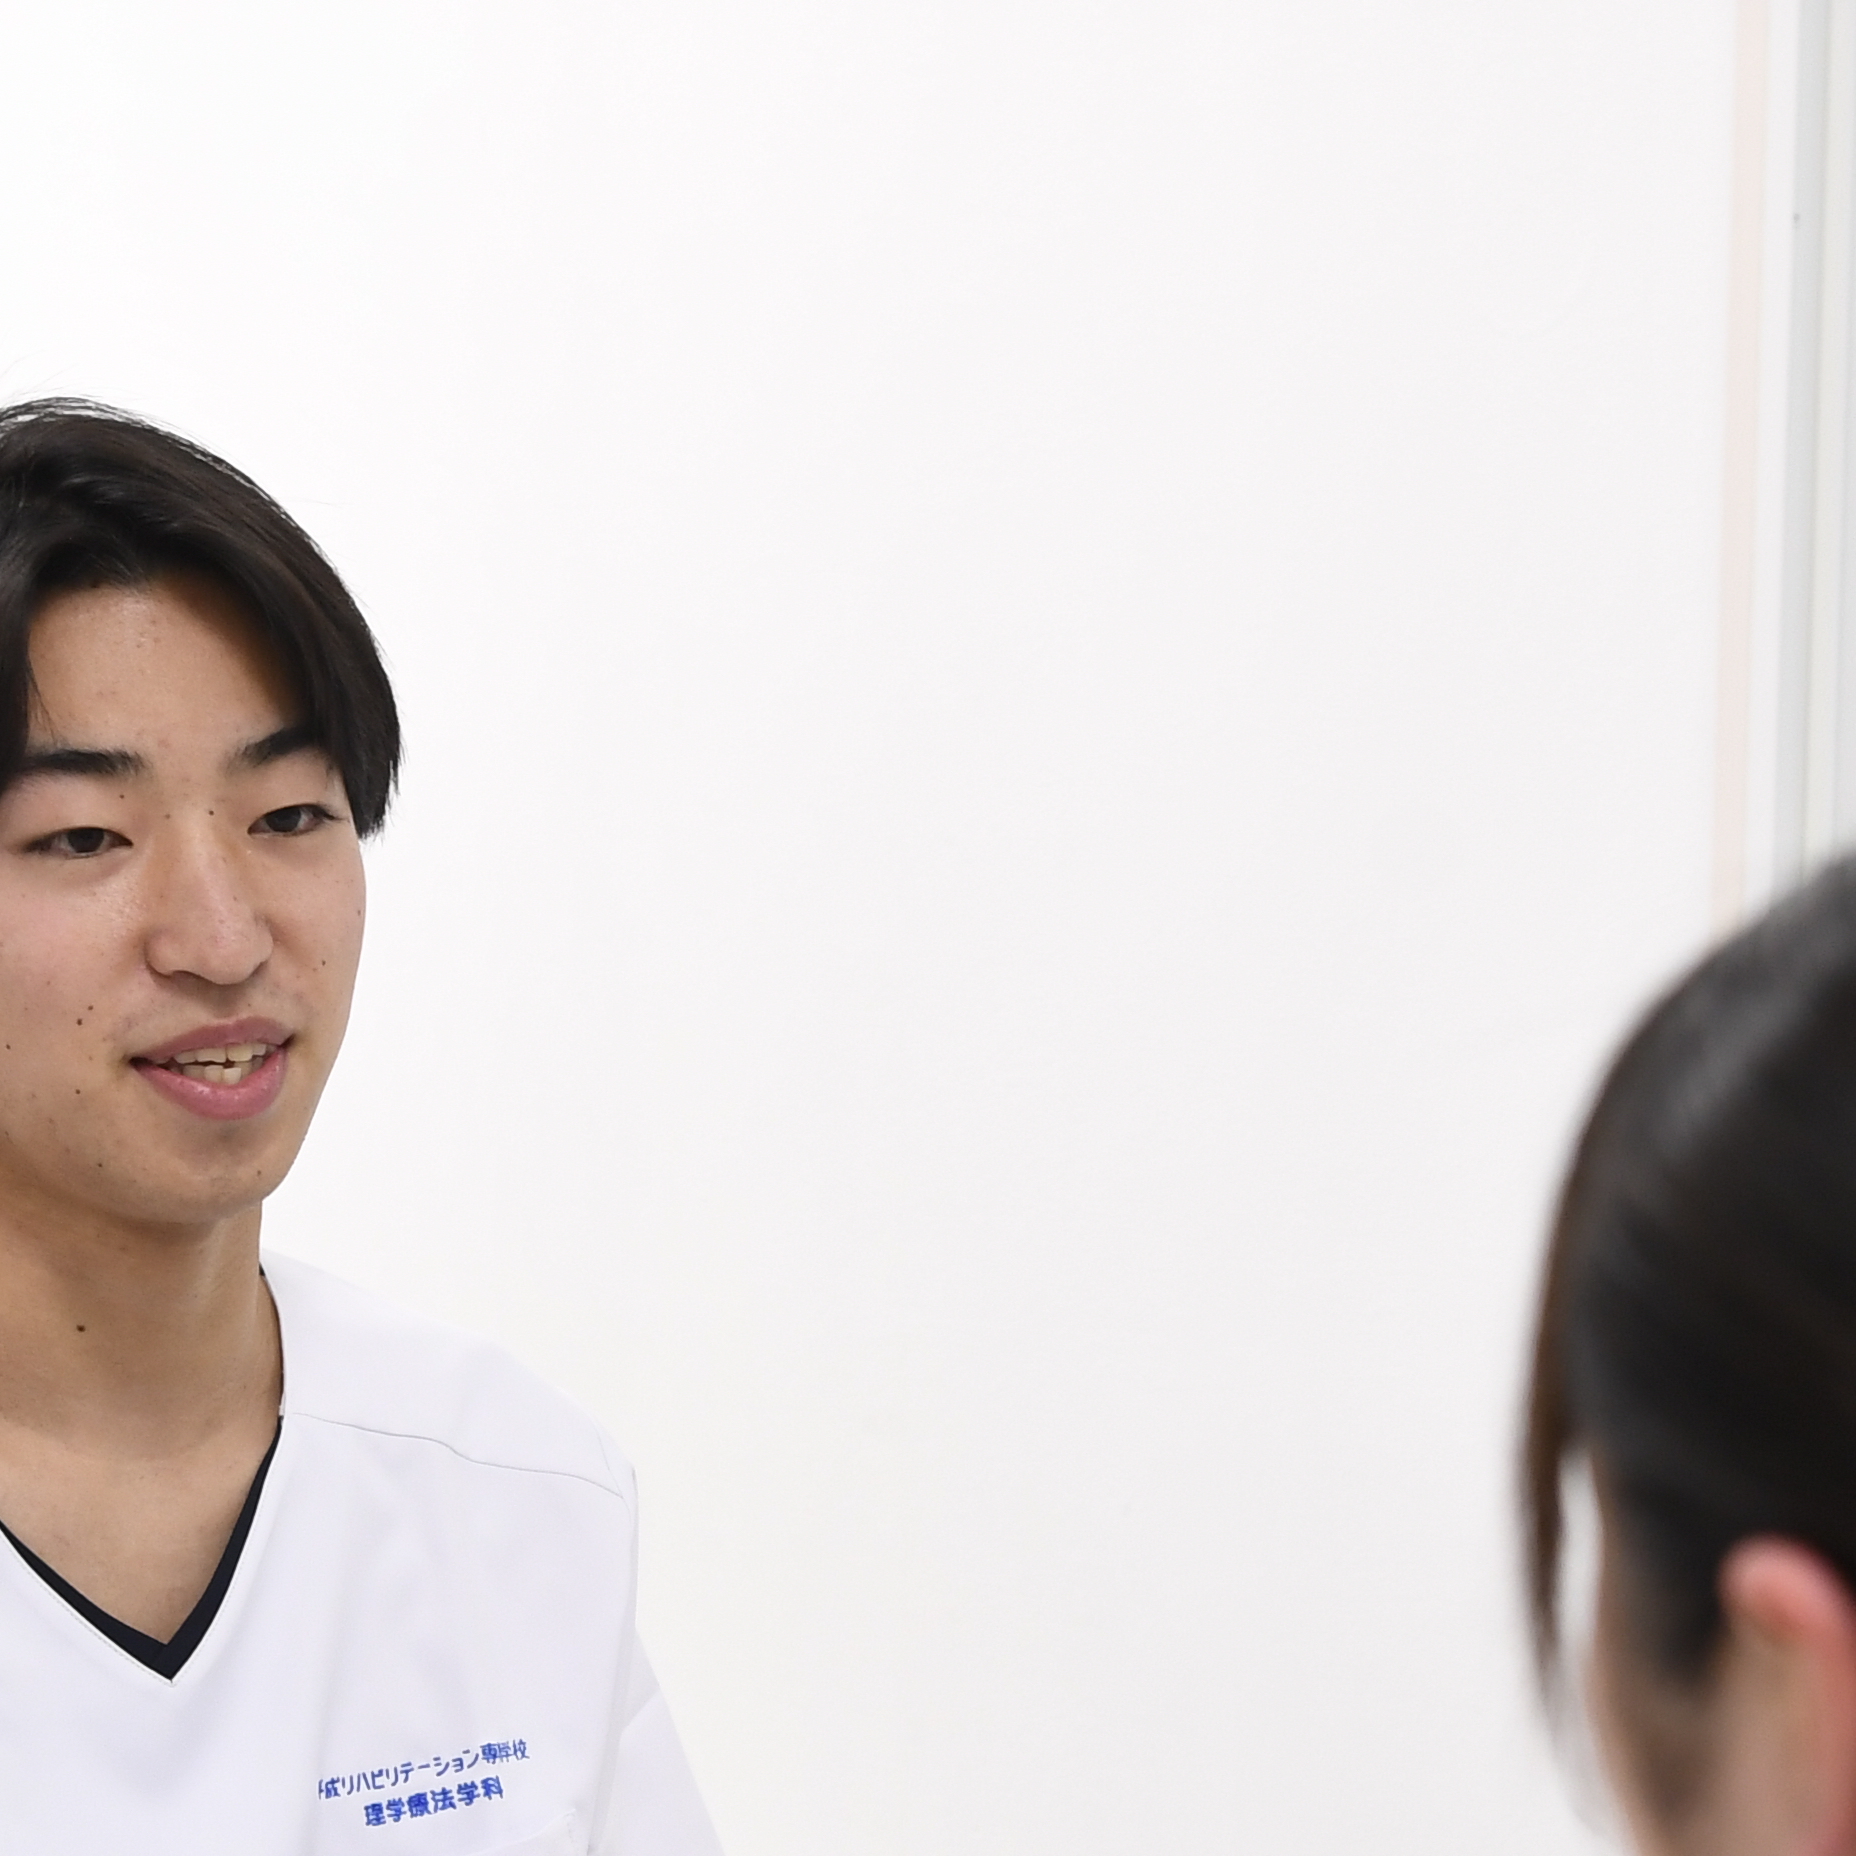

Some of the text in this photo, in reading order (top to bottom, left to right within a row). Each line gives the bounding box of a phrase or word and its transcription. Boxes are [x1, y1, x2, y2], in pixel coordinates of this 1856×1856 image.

[364, 1775, 504, 1826] 理学療法学科
